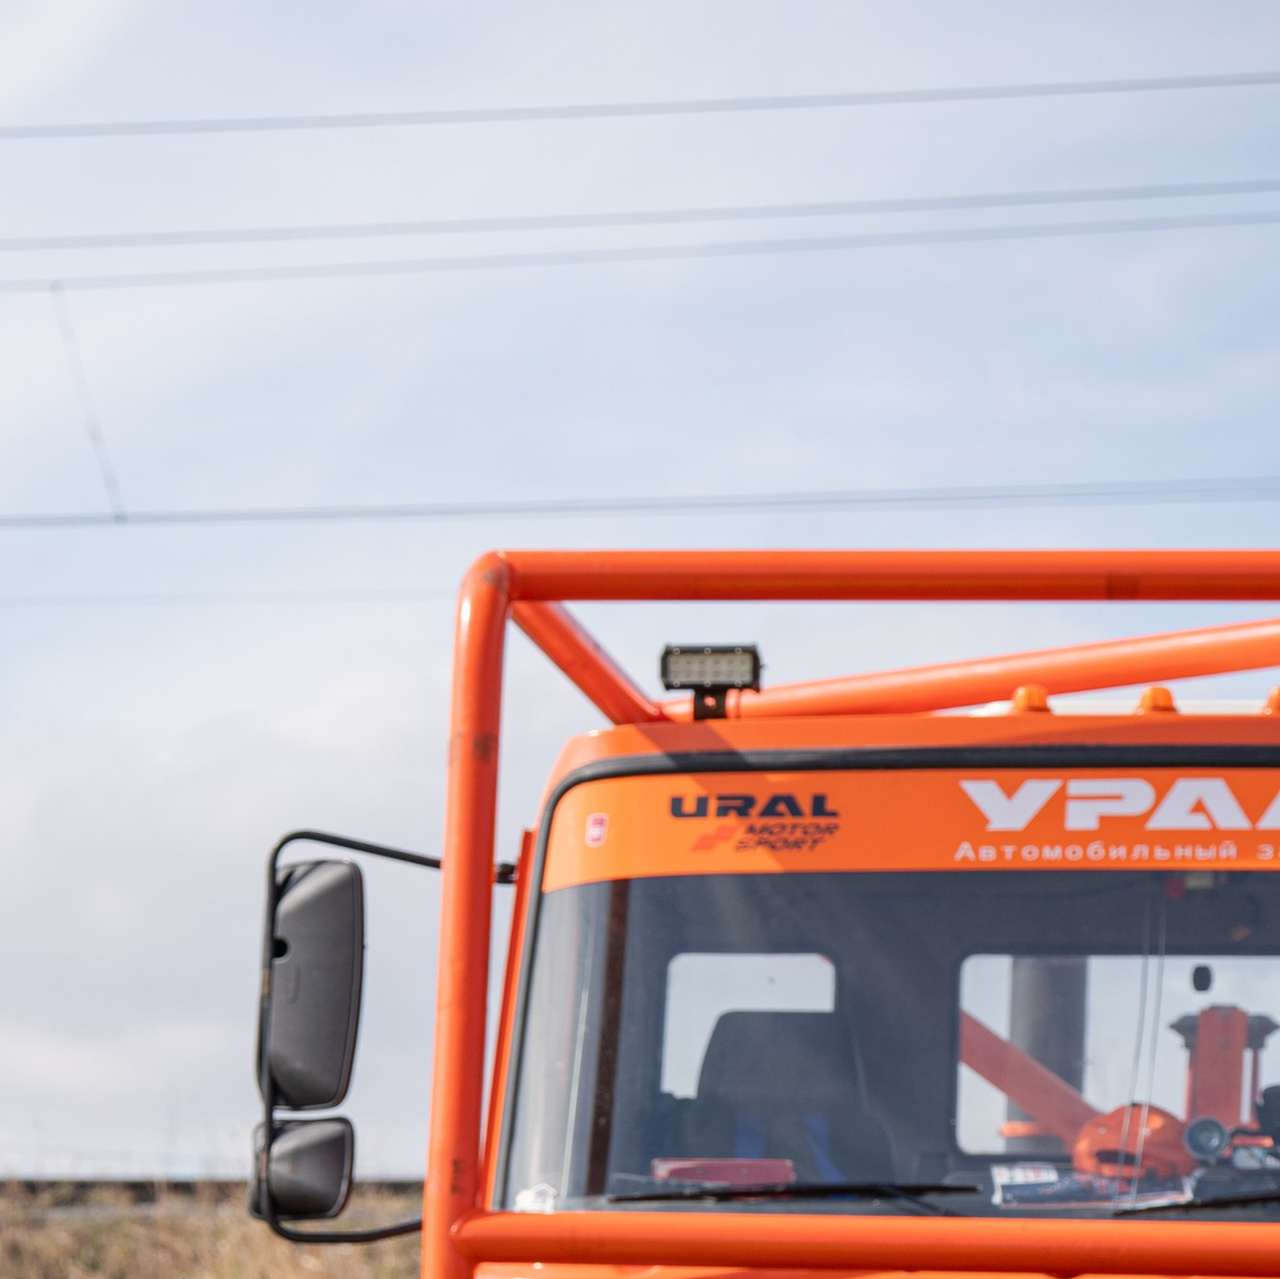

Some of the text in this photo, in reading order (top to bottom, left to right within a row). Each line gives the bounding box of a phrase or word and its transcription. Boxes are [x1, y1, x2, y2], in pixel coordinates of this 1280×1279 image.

[671, 794, 840, 818] URAL
[958, 777, 1280, 831] УРА
[746, 822, 840, 836] MOTOR
[735, 836, 825, 851] SPORT
[954, 841, 1237, 861] Автомобильный
